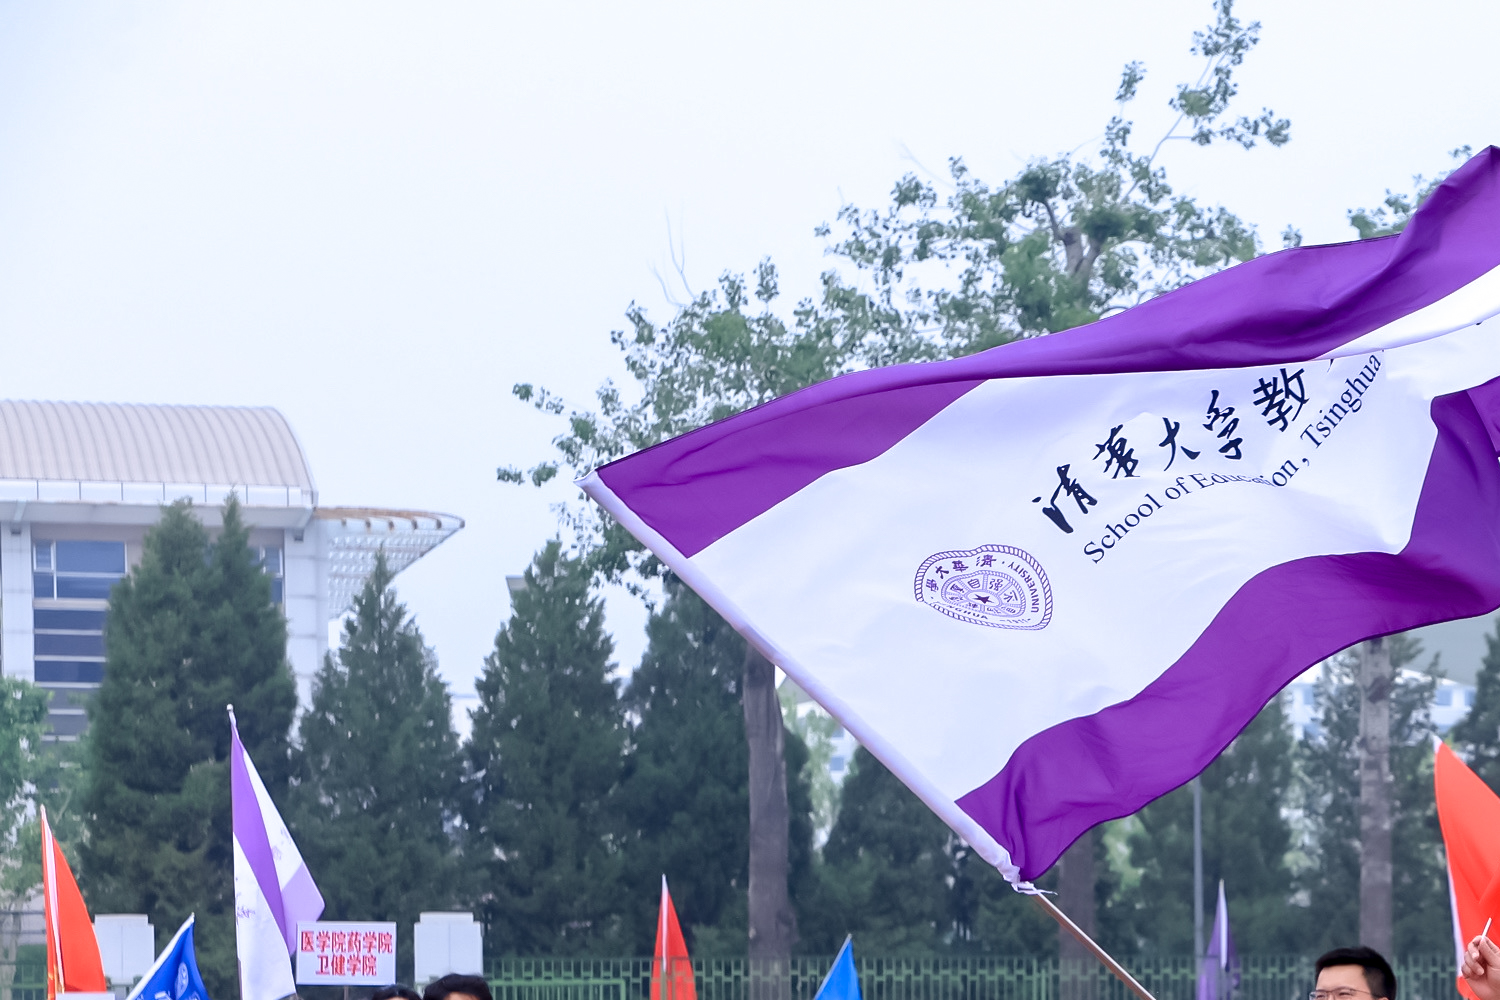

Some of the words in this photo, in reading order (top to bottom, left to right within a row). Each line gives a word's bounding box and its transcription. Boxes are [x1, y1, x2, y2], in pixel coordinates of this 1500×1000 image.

[1083, 493, 1164, 564] School
[1165, 476, 1192, 501] of
[1190, 457, 1310, 489] Educaion,
[1300, 354, 1381, 449] Tsinghua
[1007, 561, 1040, 613] UNIVERSITY
[301, 930, 393, 953] 医学院药学院
[315, 954, 377, 976] 卫健学院
